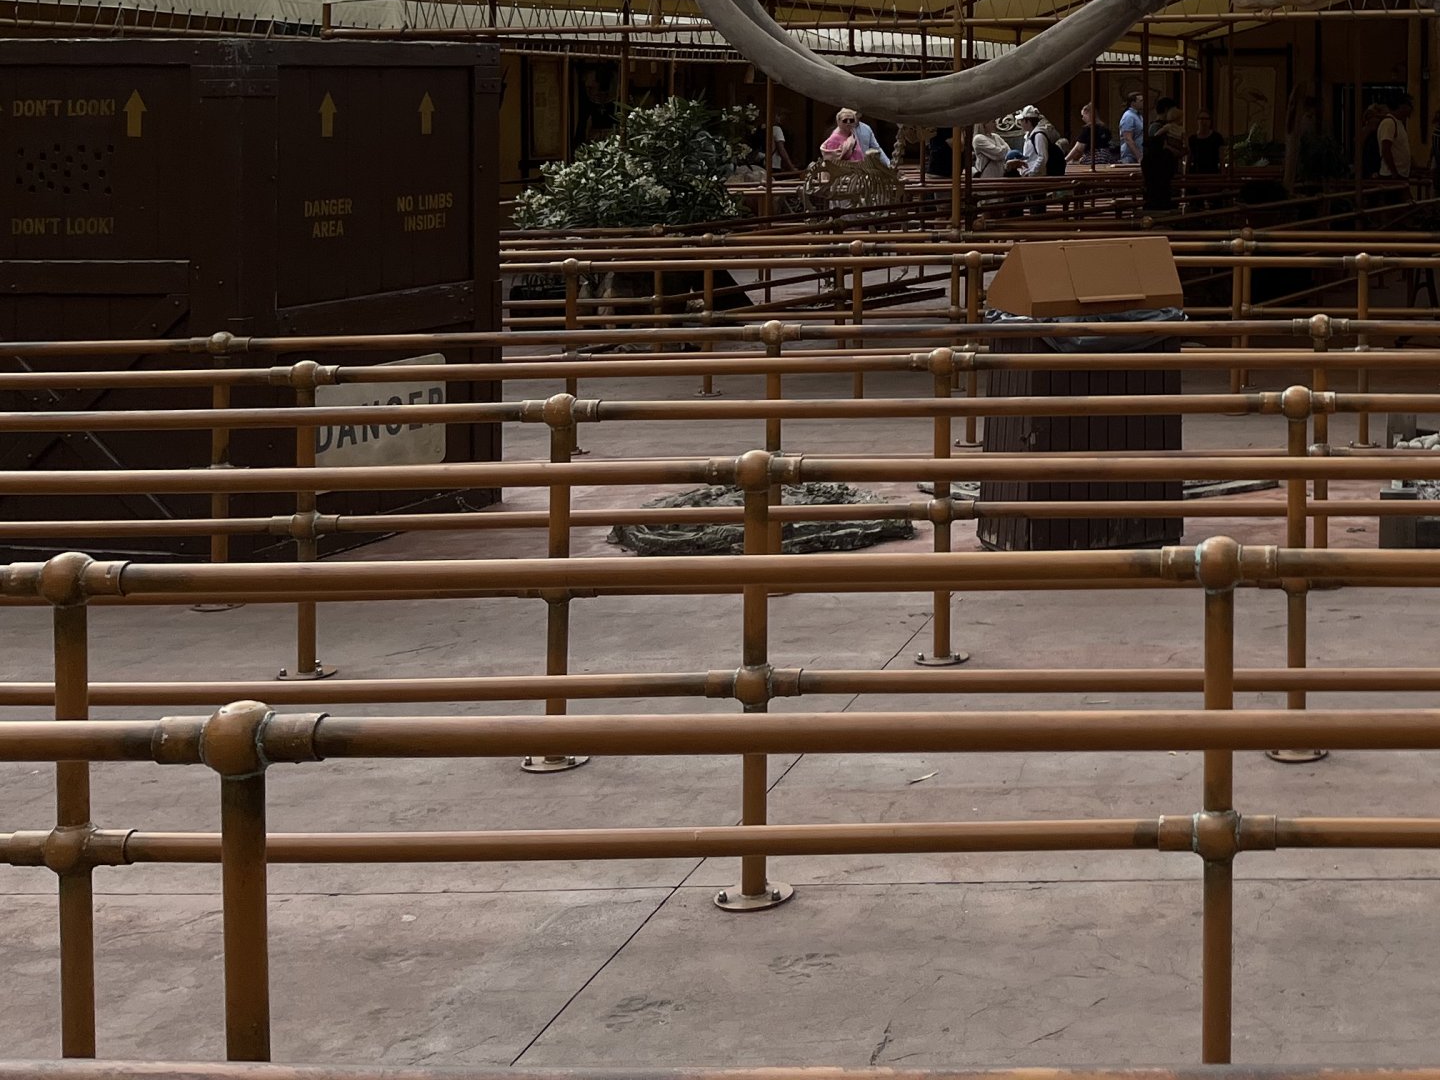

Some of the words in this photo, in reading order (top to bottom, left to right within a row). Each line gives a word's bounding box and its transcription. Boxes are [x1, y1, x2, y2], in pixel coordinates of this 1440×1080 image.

[13, 99, 62, 117] DON'T
[67, 99, 116, 117] LOOK!
[304, 198, 353, 218] DANGER
[397, 196, 413, 213] NO
[418, 192, 454, 211] LIMBS
[11, 217, 60, 236] DON'T
[66, 217, 114, 235] LOOK!
[312, 220, 345, 239] AREA
[404, 212, 446, 232] INSIDE!
